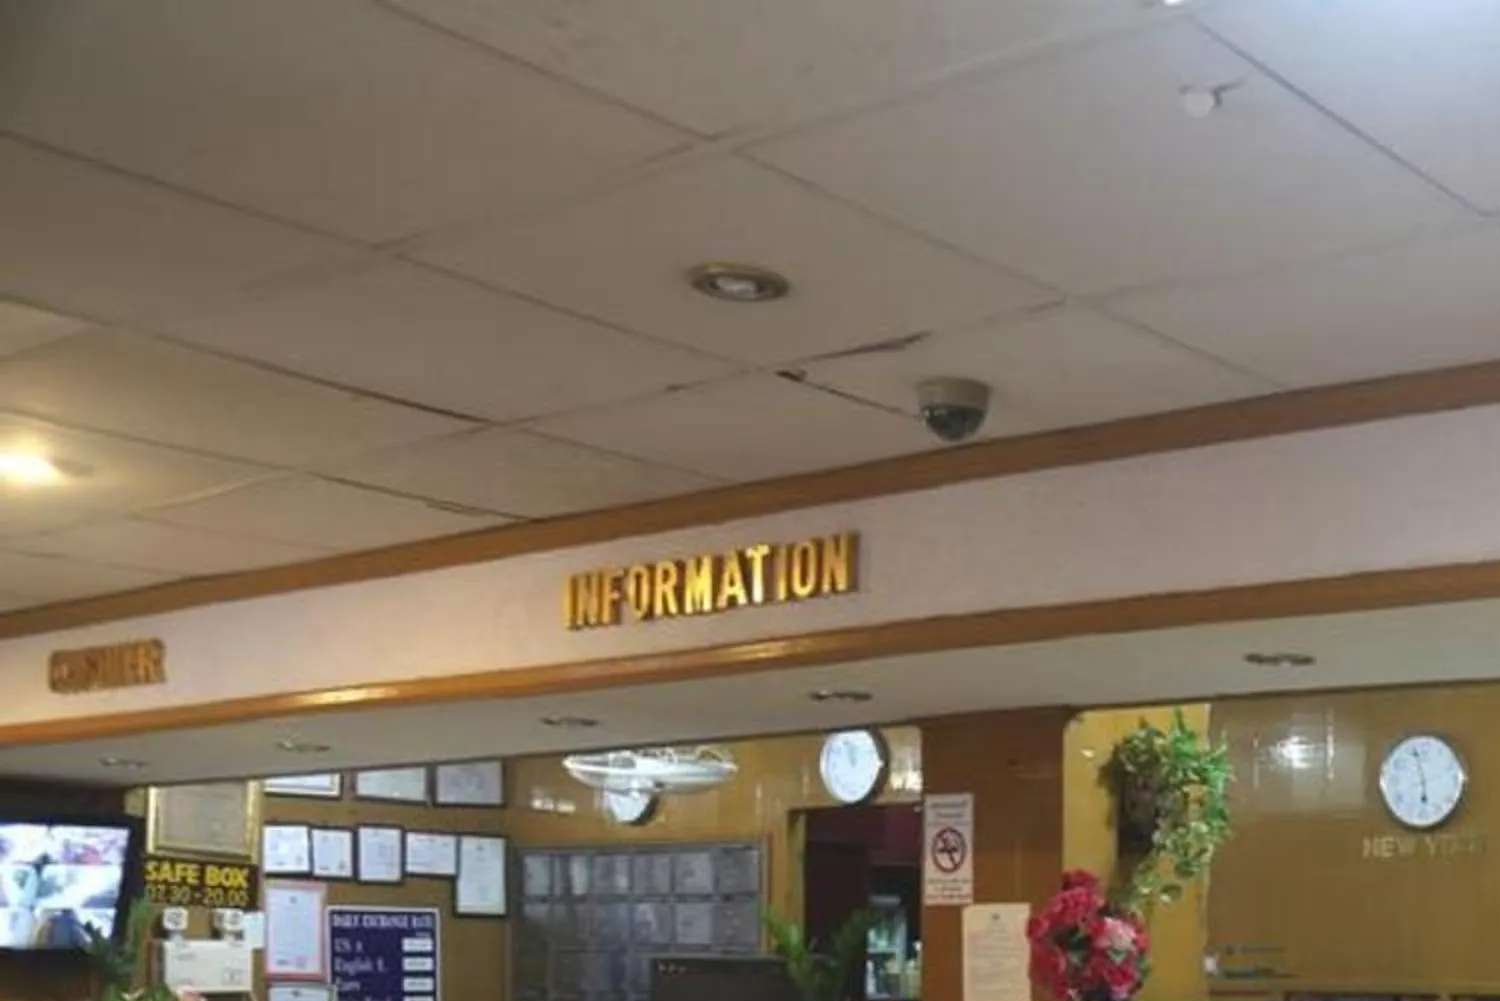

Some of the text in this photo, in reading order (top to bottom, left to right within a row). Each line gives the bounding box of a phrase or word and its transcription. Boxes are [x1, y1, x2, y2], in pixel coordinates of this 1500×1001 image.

[564, 531, 860, 630] INFORMATION
[144, 860, 250, 889] SAFE BOX
